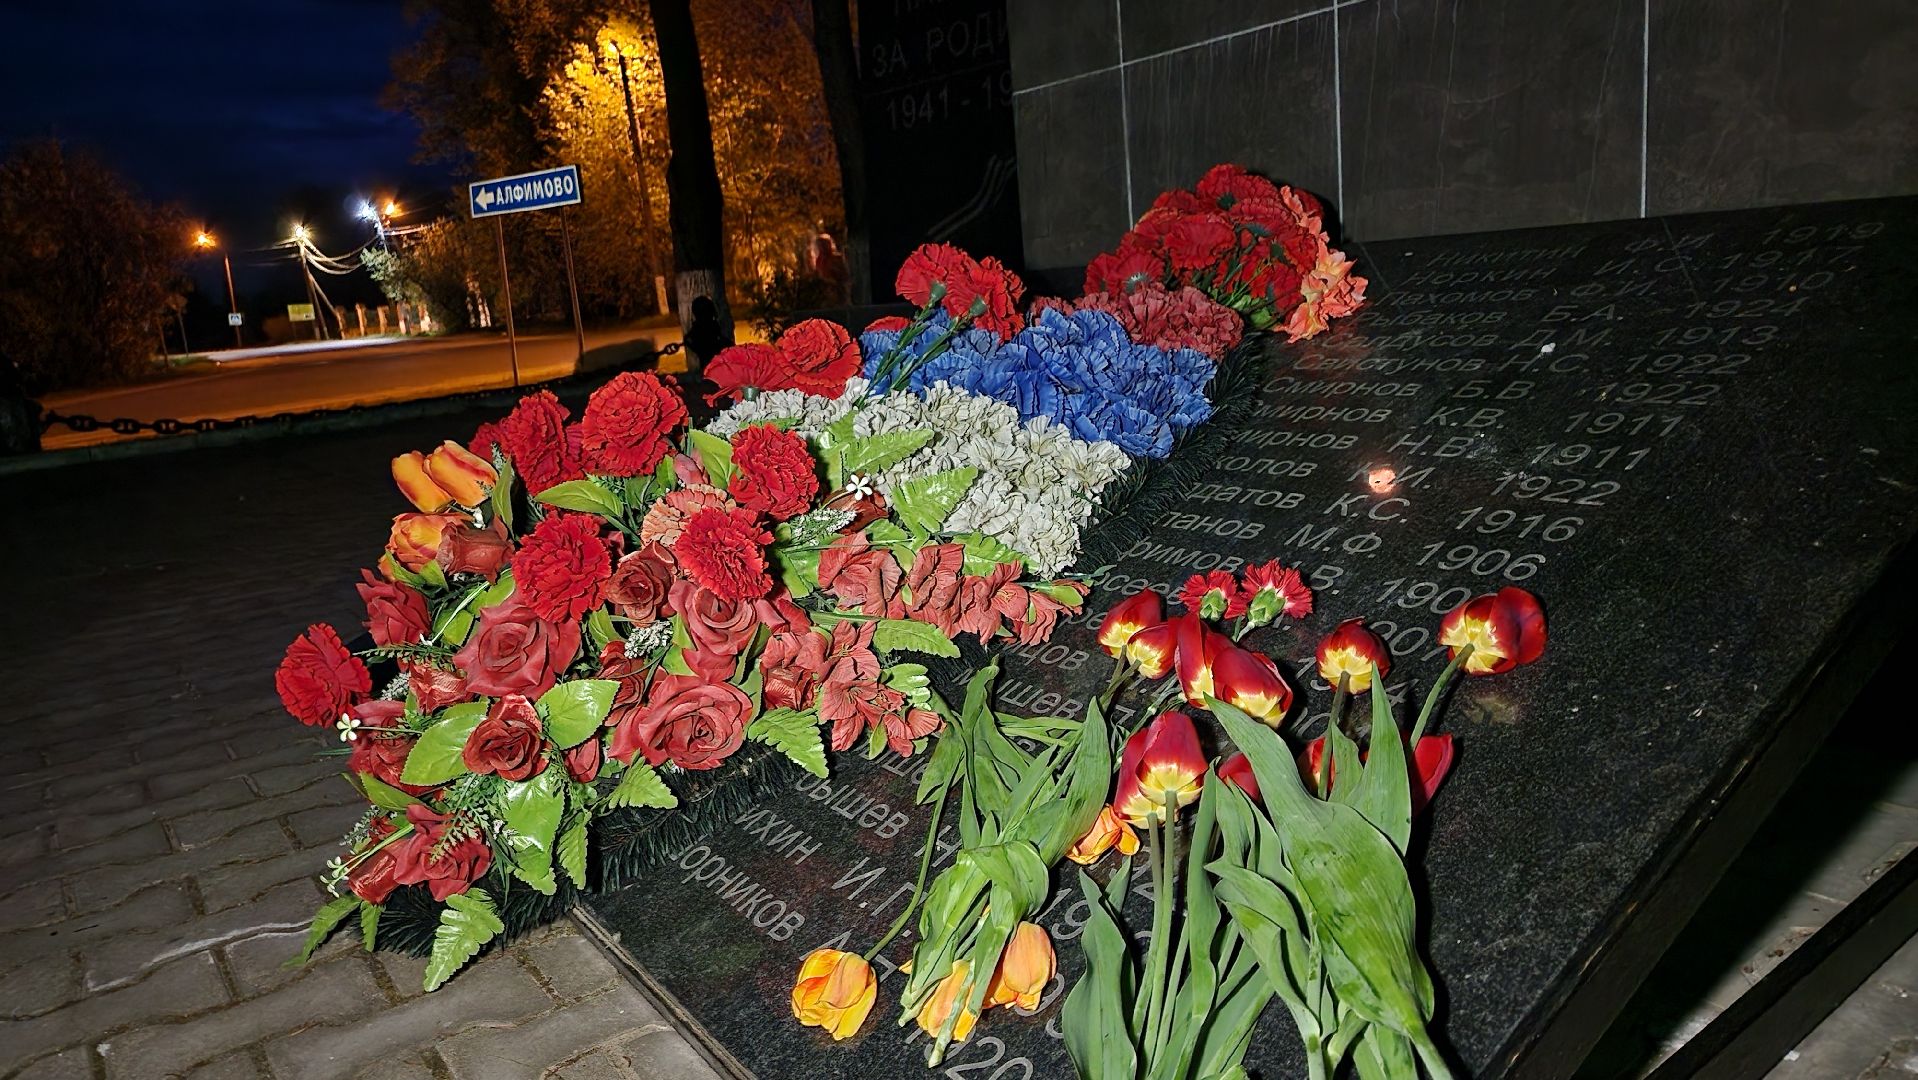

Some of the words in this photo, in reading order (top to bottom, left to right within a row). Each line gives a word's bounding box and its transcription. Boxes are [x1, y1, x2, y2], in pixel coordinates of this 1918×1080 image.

[872, 40, 908, 78] ЗА
[886, 84, 949, 130] 1941
[496, 175, 574, 206] АЛФИМОВО
[1762, 221, 1886, 246] 1919
[1720, 245, 1865, 270] 1917
[1713, 271, 1835, 294] 1910
[1351, 309, 1509, 328] Рыбаков
[1684, 296, 1811, 320] 1924
[1508, 327, 1613, 351] ДМ.
[1655, 325, 1781, 346] 1913
[1293, 354, 1487, 376] Свистунов
[1624, 352, 1752, 375] 1922
[1262, 376, 1424, 399] Смирнов
[1452, 379, 1536, 401] Б.В.
[1595, 381, 1722, 406] 1922
[1252, 400, 1393, 424] мирнов
[1423, 405, 1506, 430] К.В.
[1564, 411, 1685, 438] 1911
[1531, 442, 1651, 472] 1911
[1346, 462, 1437, 490] КИ.
[1490, 472, 1622, 506] 1922
[1323, 492, 1409, 524] К.С.
[1455, 506, 1585, 543] 1916
[1283, 523, 1384, 559] М.Ф.
[1415, 541, 1547, 581] 1906
[1376, 577, 1498, 615] 190
[670, 834, 806, 942] орников
